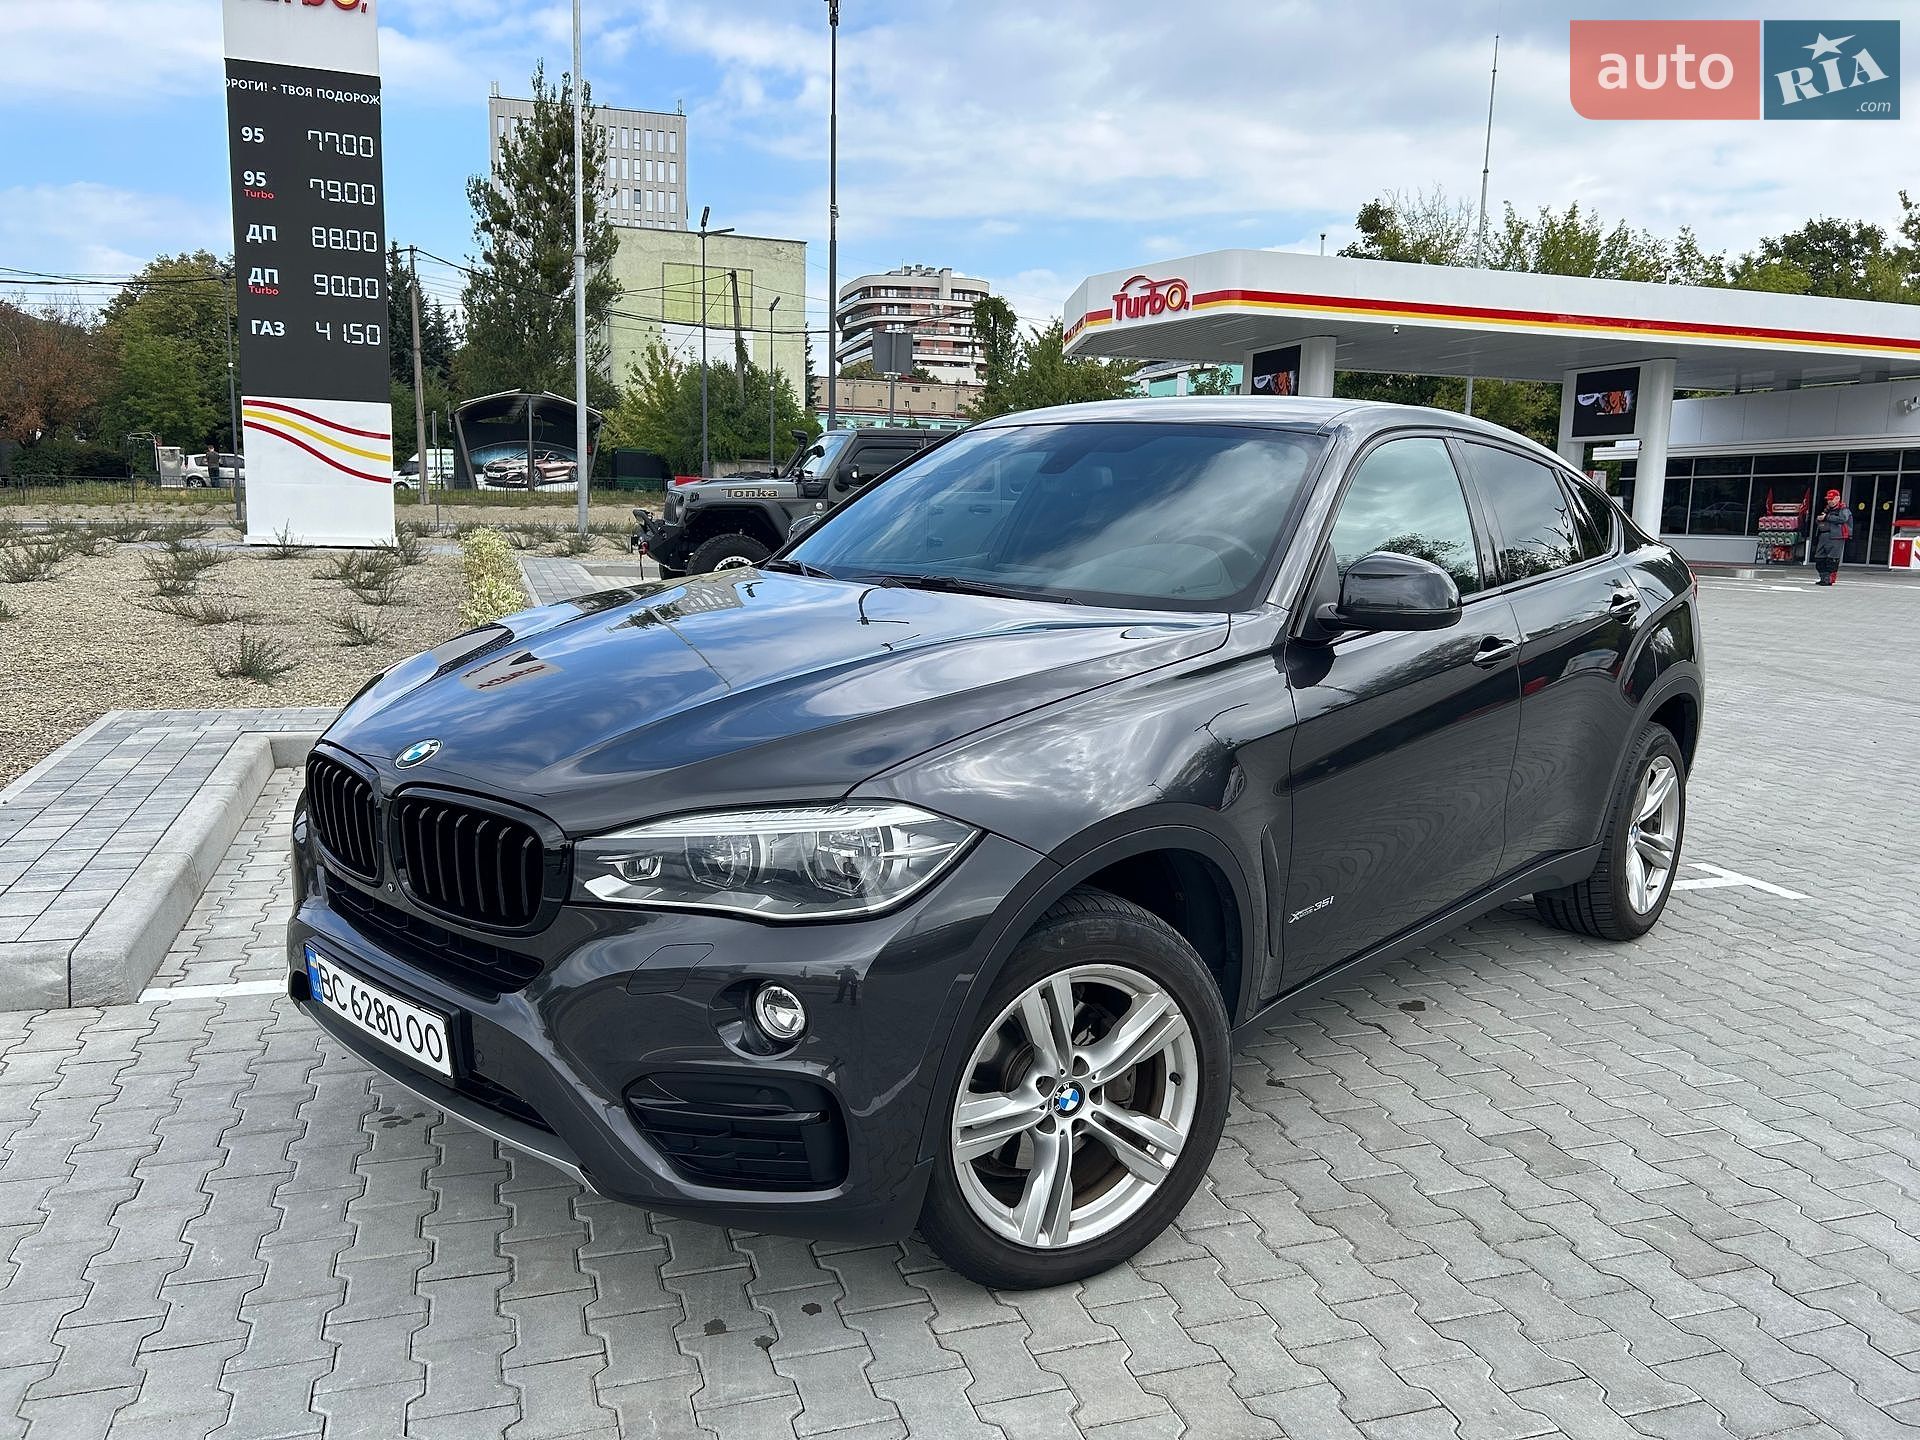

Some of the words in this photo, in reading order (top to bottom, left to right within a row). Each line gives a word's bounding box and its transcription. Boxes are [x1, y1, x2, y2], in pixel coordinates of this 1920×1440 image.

[280, 83, 313, 98] ТВОЯ
[316, 88, 381, 105] ПОДОРОЖ
[241, 126, 265, 144] 95
[307, 129, 374, 158] 77.00
[243, 170, 267, 187] 95
[309, 178, 376, 206] 79.00
[243, 188, 275, 200] Turbo
[245, 223, 277, 244] ДП
[311, 226, 378, 253] 88.00
[248, 267, 279, 287] ДП
[313, 273, 379, 300] 90.00
[249, 285, 280, 296] Turbo
[251, 319, 286, 337] ГАЗ
[721, 487, 779, 499] Tonka
[317, 962, 348, 1012] BC
[350, 984, 402, 1043] 6280
